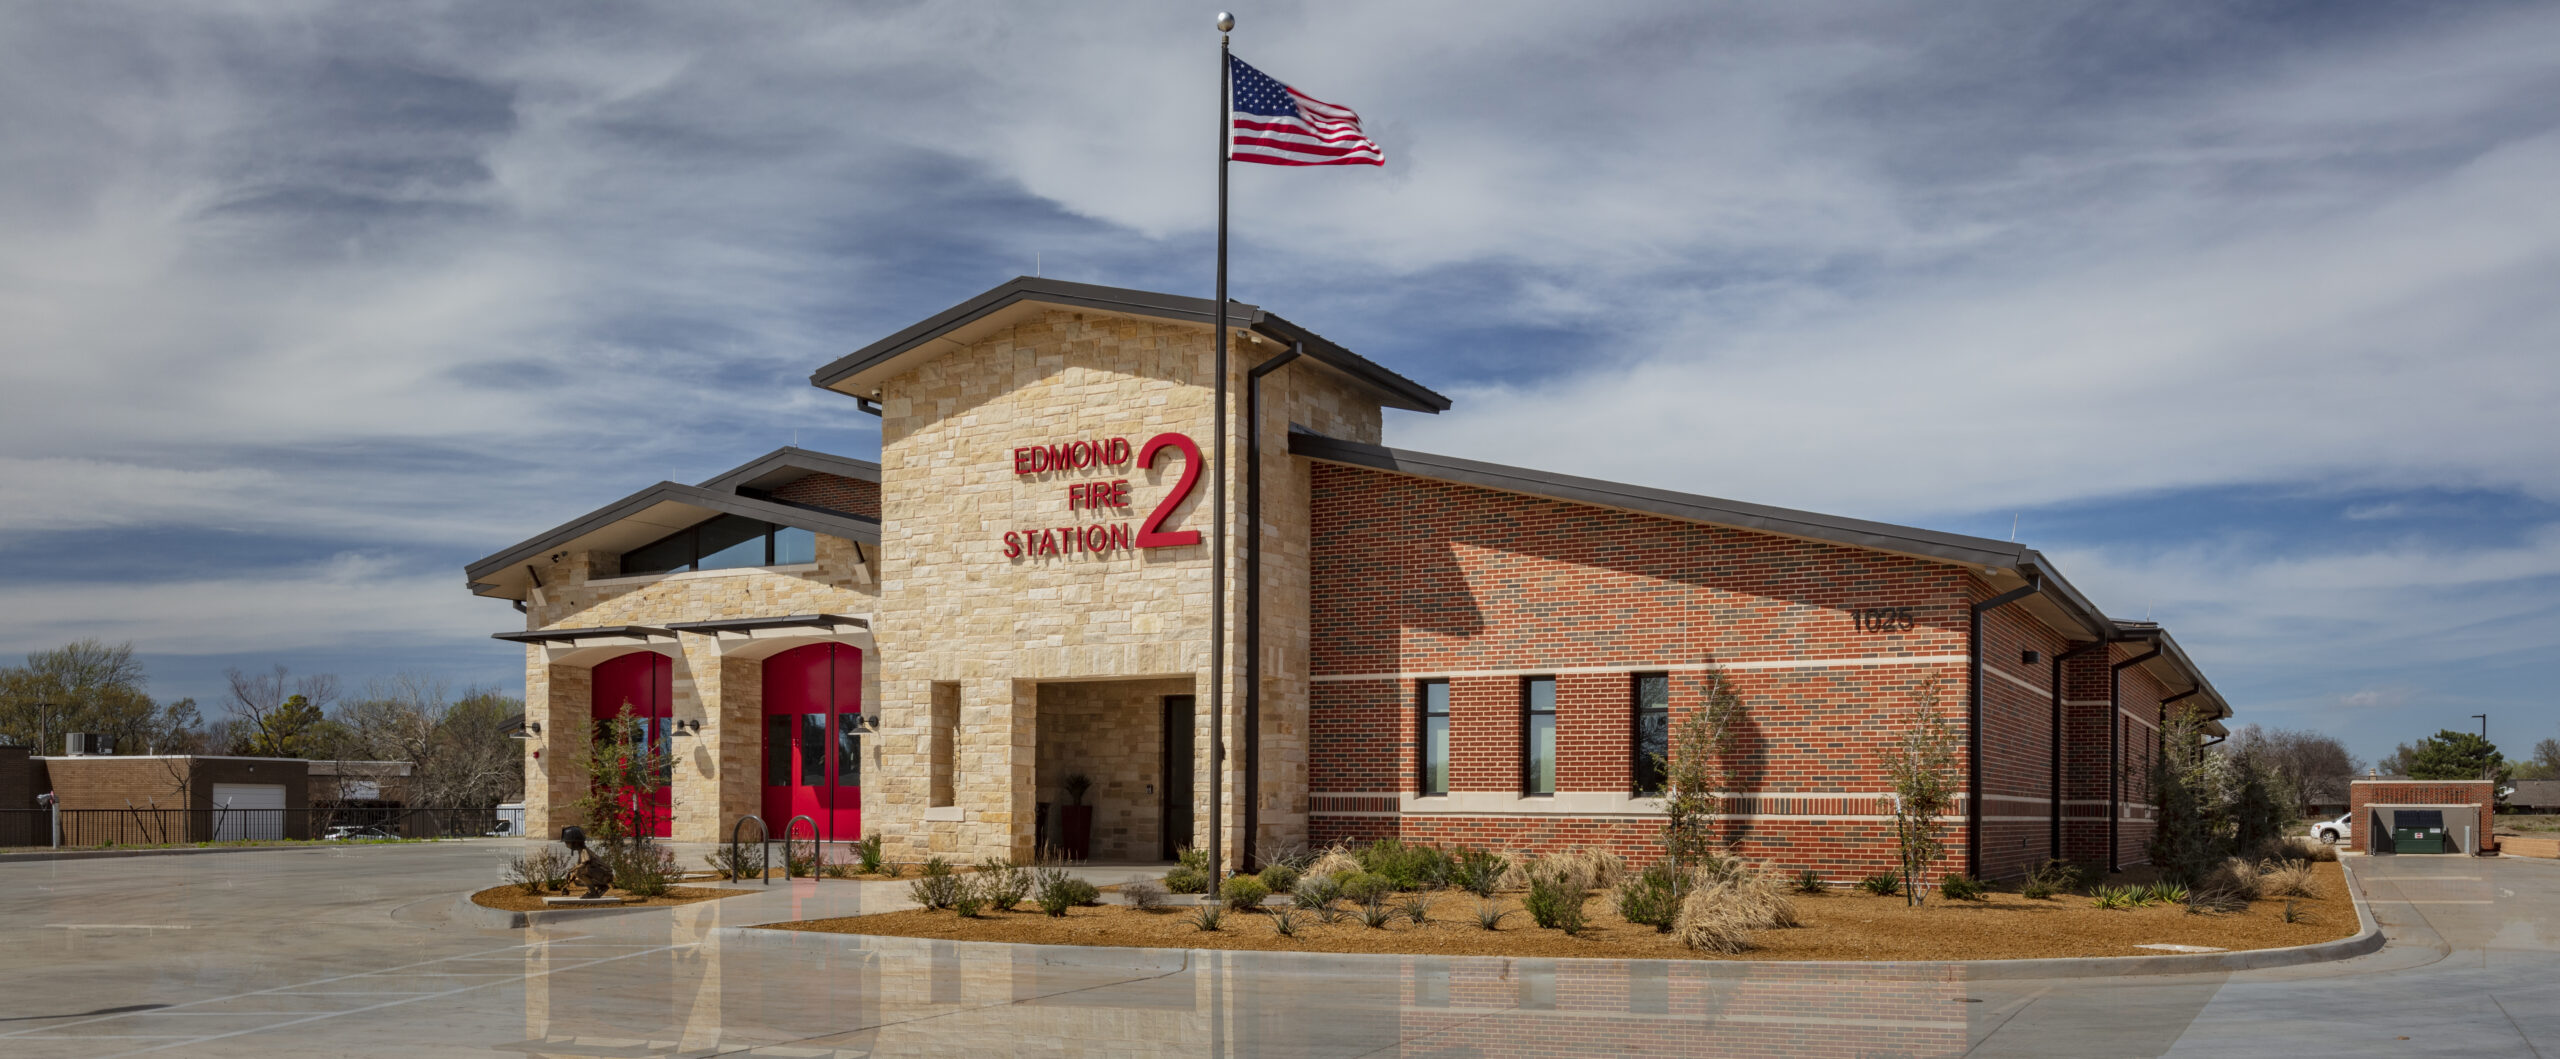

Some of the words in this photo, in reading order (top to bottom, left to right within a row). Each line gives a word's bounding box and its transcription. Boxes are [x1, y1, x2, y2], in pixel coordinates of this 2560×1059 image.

[1014, 437, 1130, 475] EDMOND
[1068, 479, 1129, 511] FIRE
[1134, 431, 1202, 549] 2
[1003, 522, 1129, 558] STATION
[1850, 606, 1913, 633] 1025
